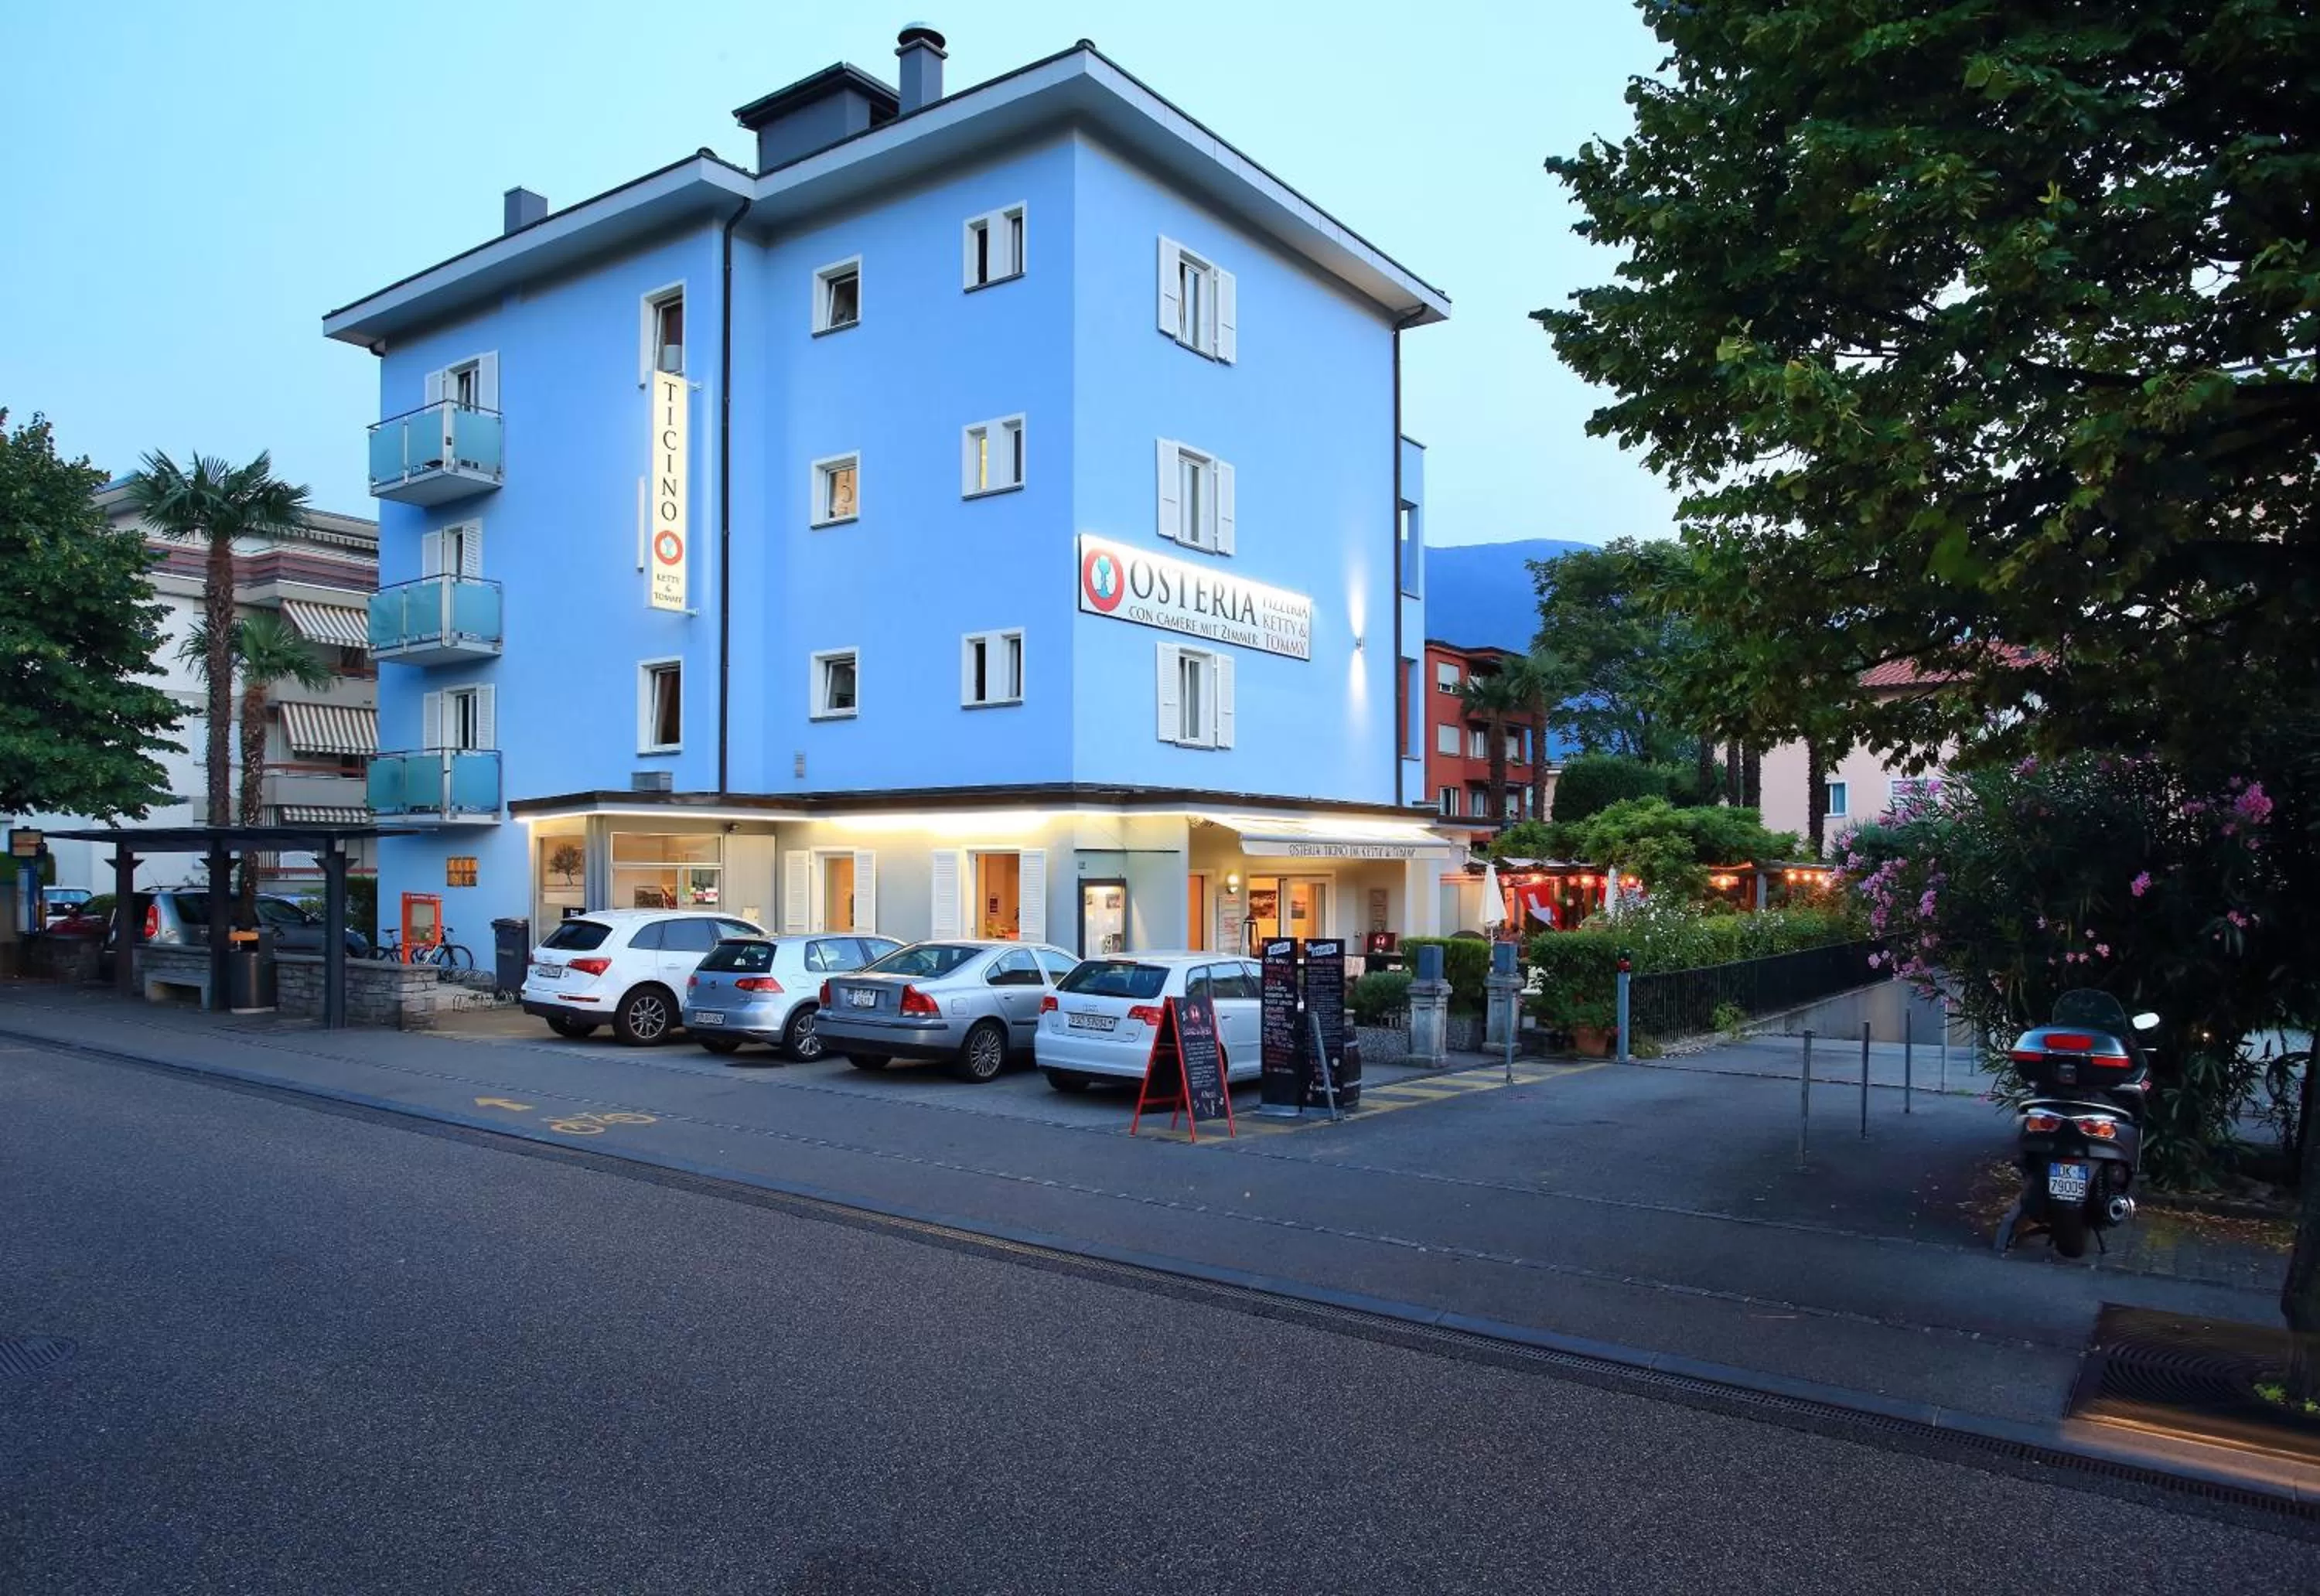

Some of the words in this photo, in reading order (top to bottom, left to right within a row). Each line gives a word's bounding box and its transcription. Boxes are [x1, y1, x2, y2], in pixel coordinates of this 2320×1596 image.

[662, 382, 678, 521] TICINO
[657, 573, 681, 585] KETTY
[1130, 558, 1258, 626] OSTERIA
[1128, 605, 1154, 622] CON
[1156, 612, 1197, 633] CAMERE
[1199, 622, 1218, 637] MIT
[1221, 624, 1259, 646] ZIMMER
[1263, 612, 1296, 636] KETTY
[1299, 622, 1308, 638] &
[1263, 632, 1306, 656] TOMMY
